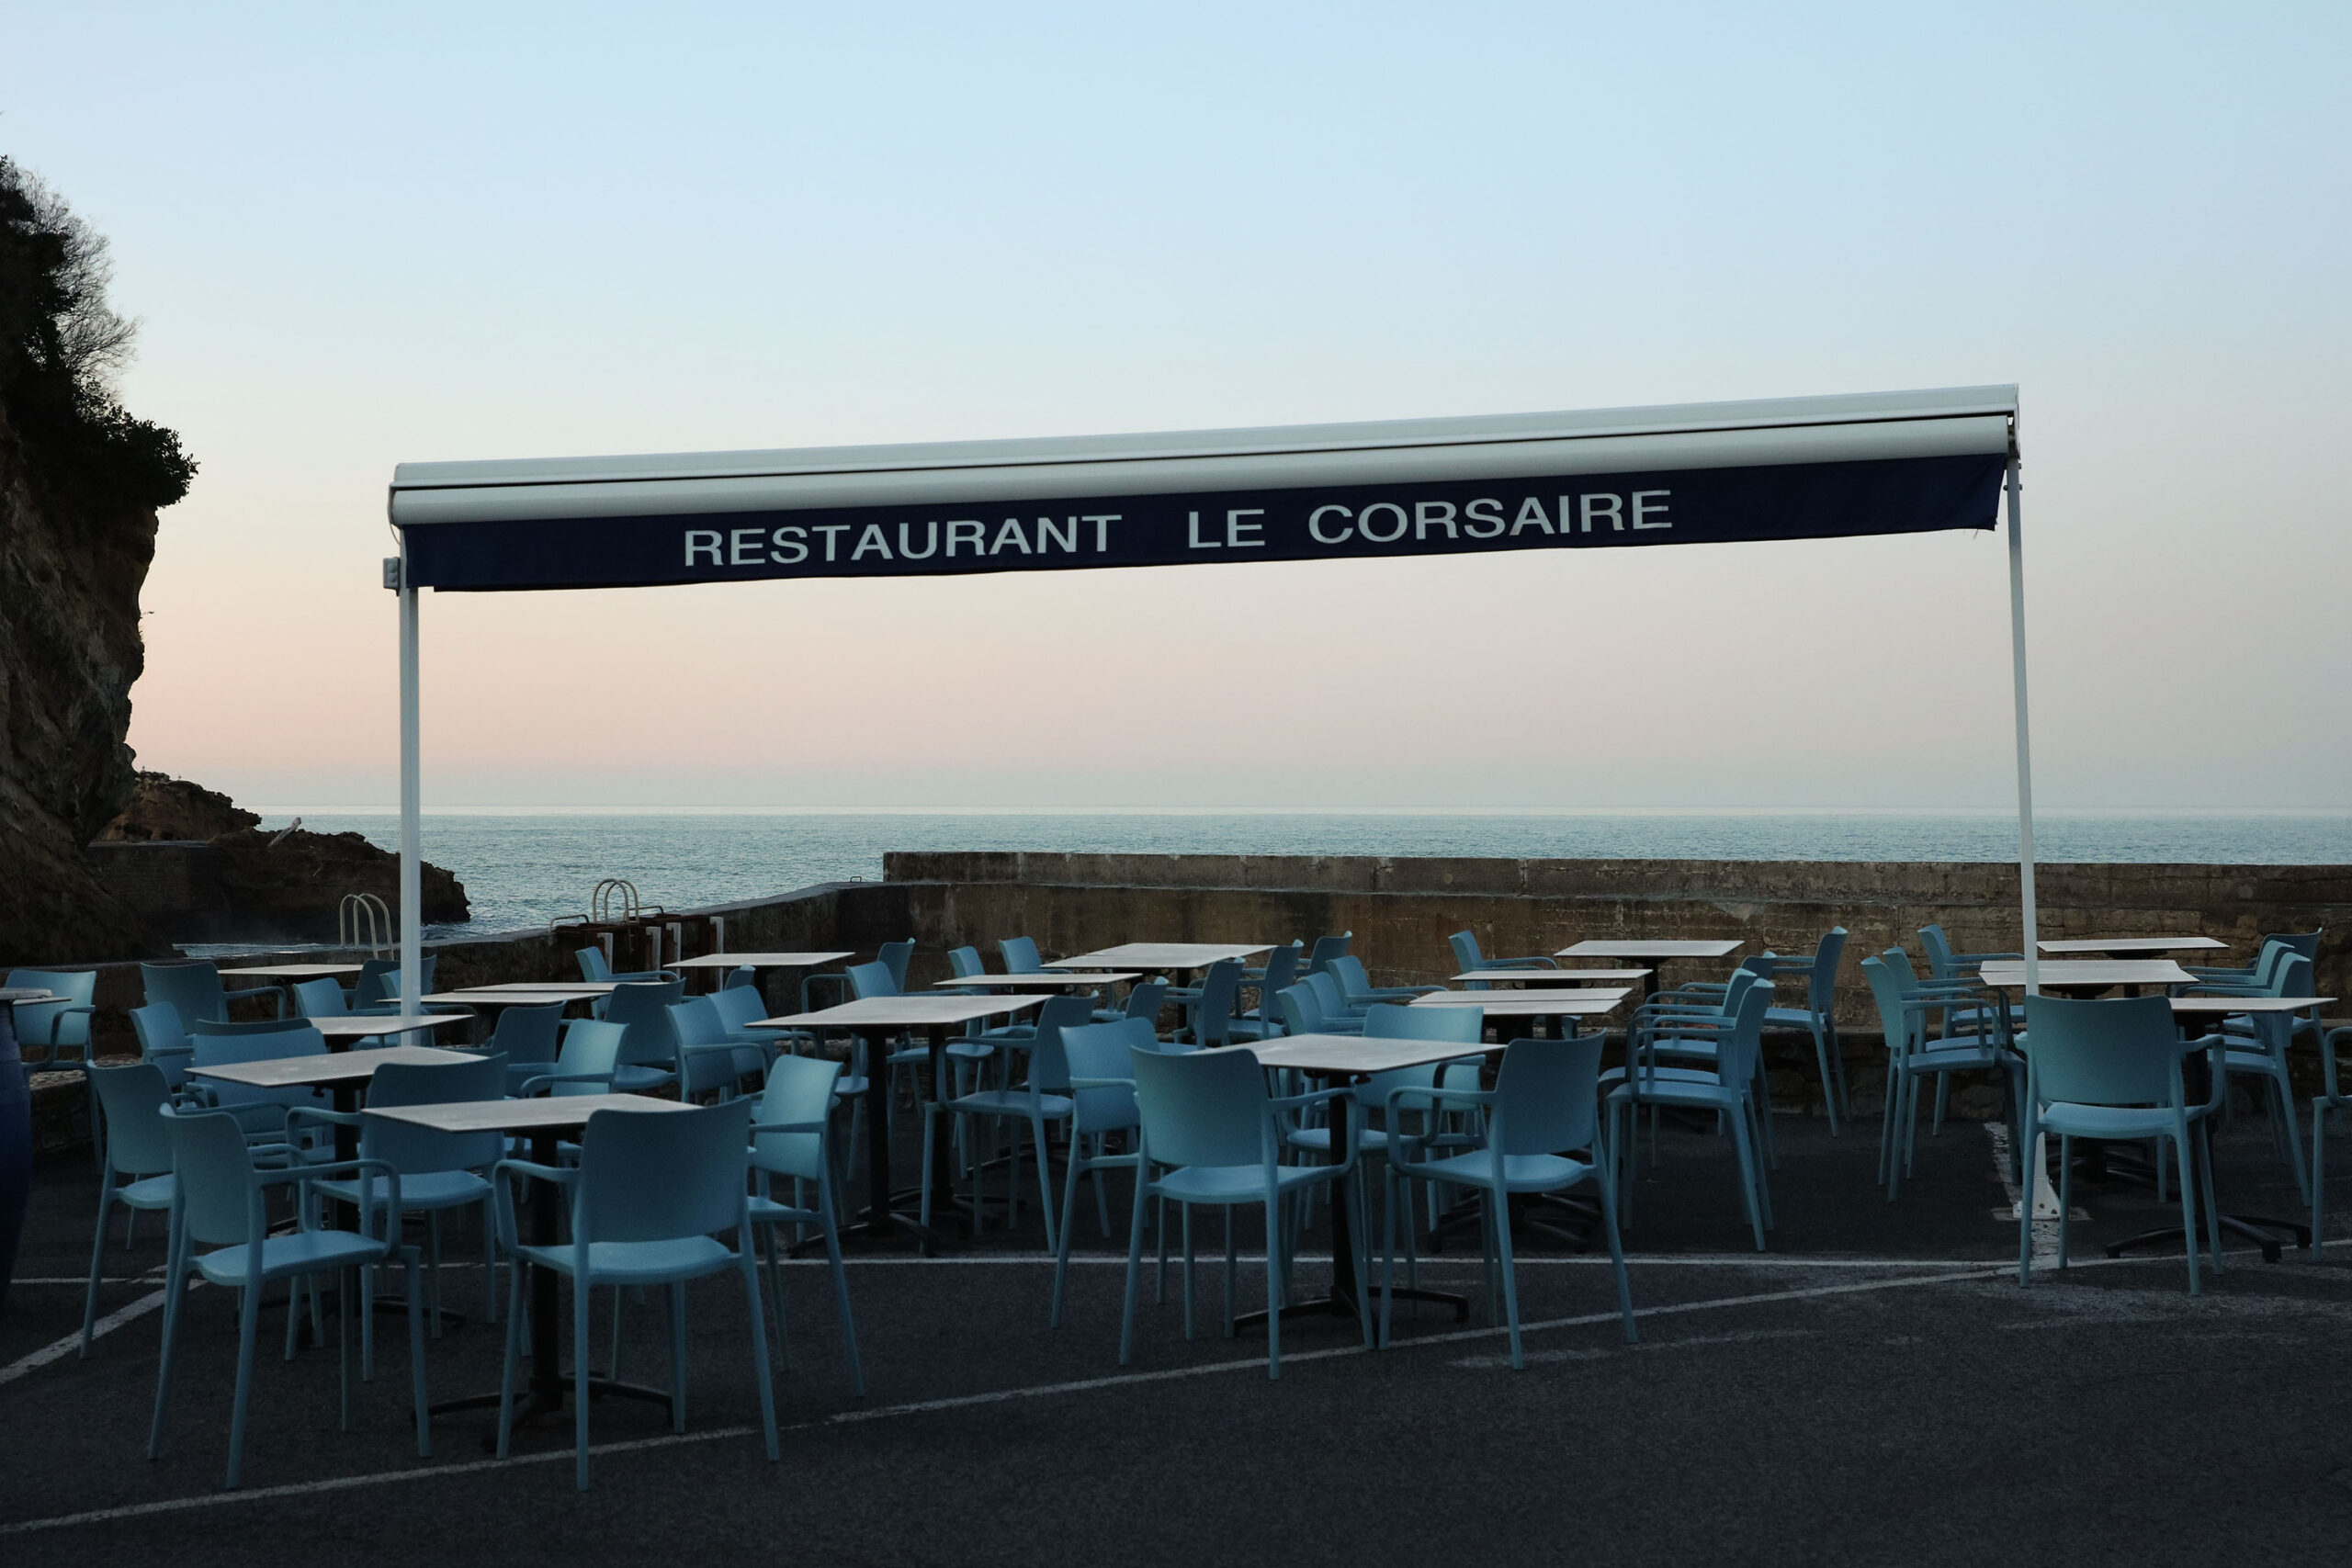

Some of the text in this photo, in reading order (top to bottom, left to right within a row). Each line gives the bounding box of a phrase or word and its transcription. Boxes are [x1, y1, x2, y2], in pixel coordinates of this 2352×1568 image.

[684, 490, 1673, 567] RESTAURANT LE CORSAIRE
